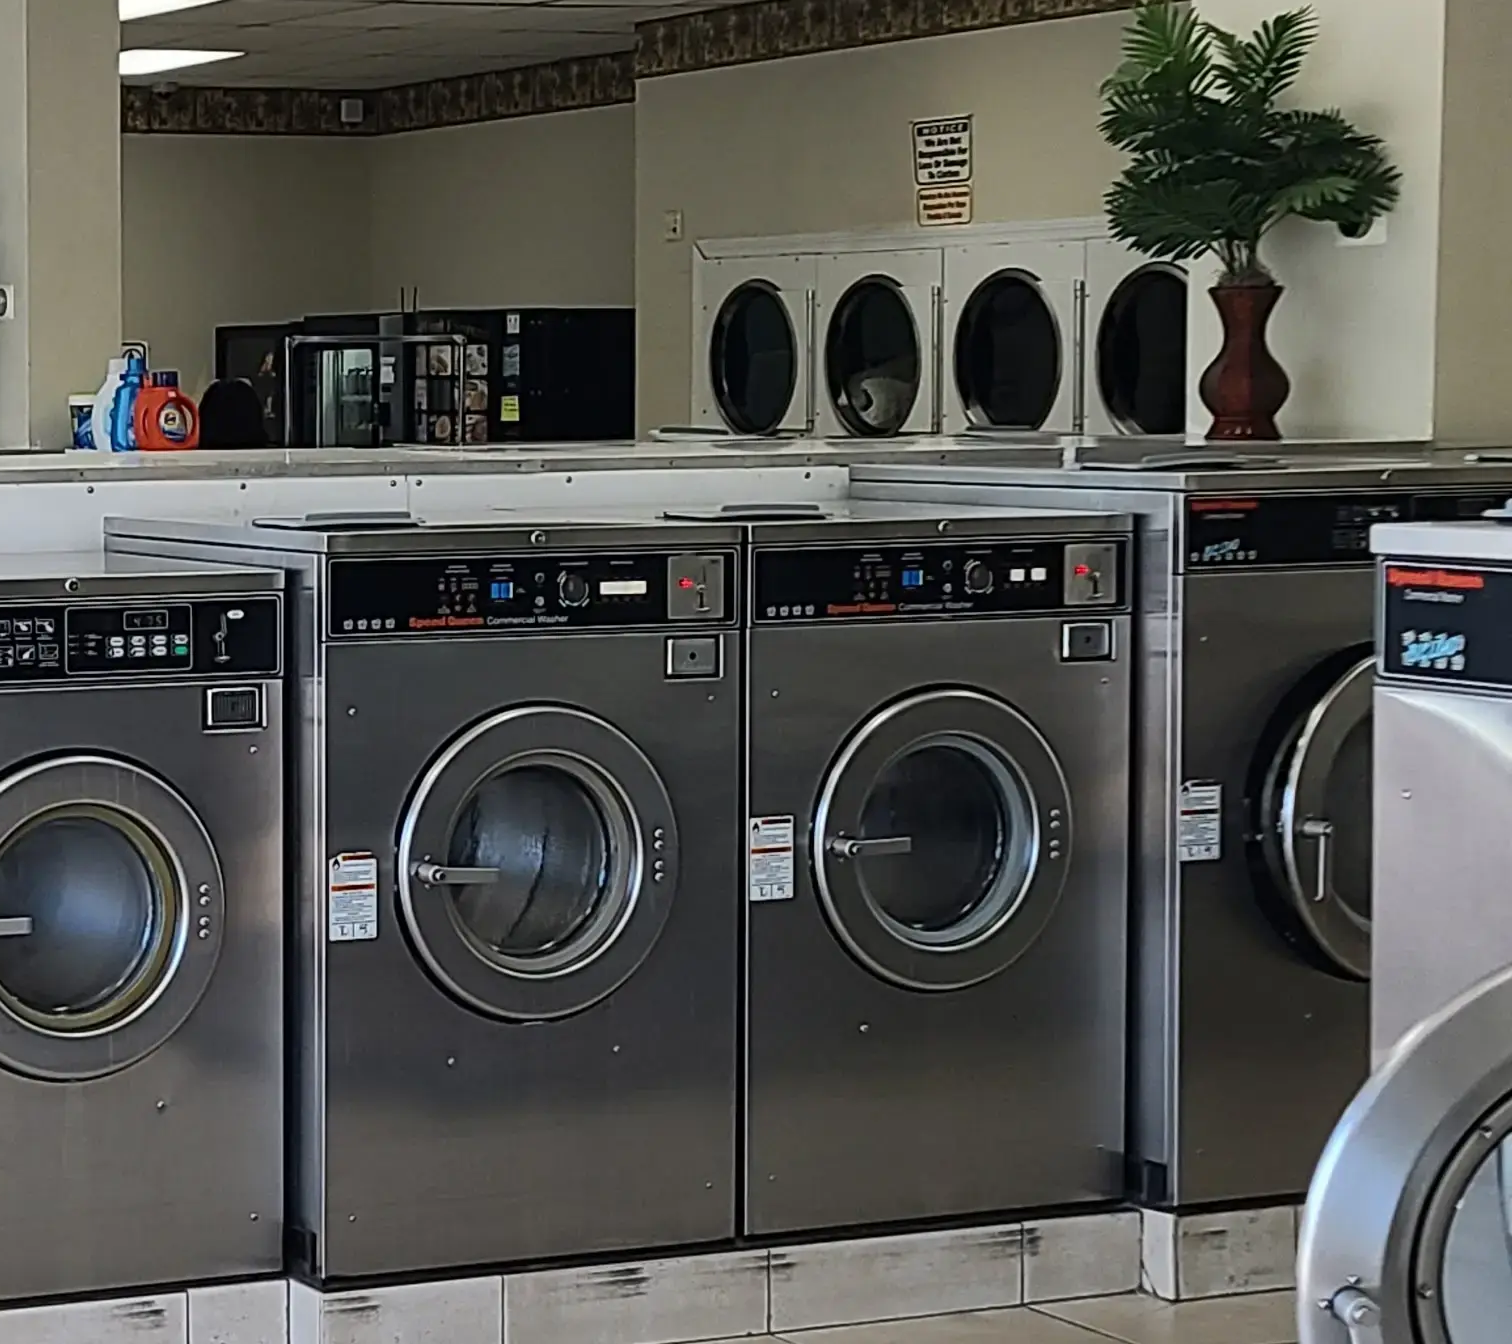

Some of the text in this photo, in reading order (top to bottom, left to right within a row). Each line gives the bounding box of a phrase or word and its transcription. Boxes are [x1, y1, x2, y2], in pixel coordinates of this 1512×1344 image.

[922, 124, 964, 134] NOTICE
[487, 616, 535, 626] Commercial
[537, 615, 569, 624] Washer
